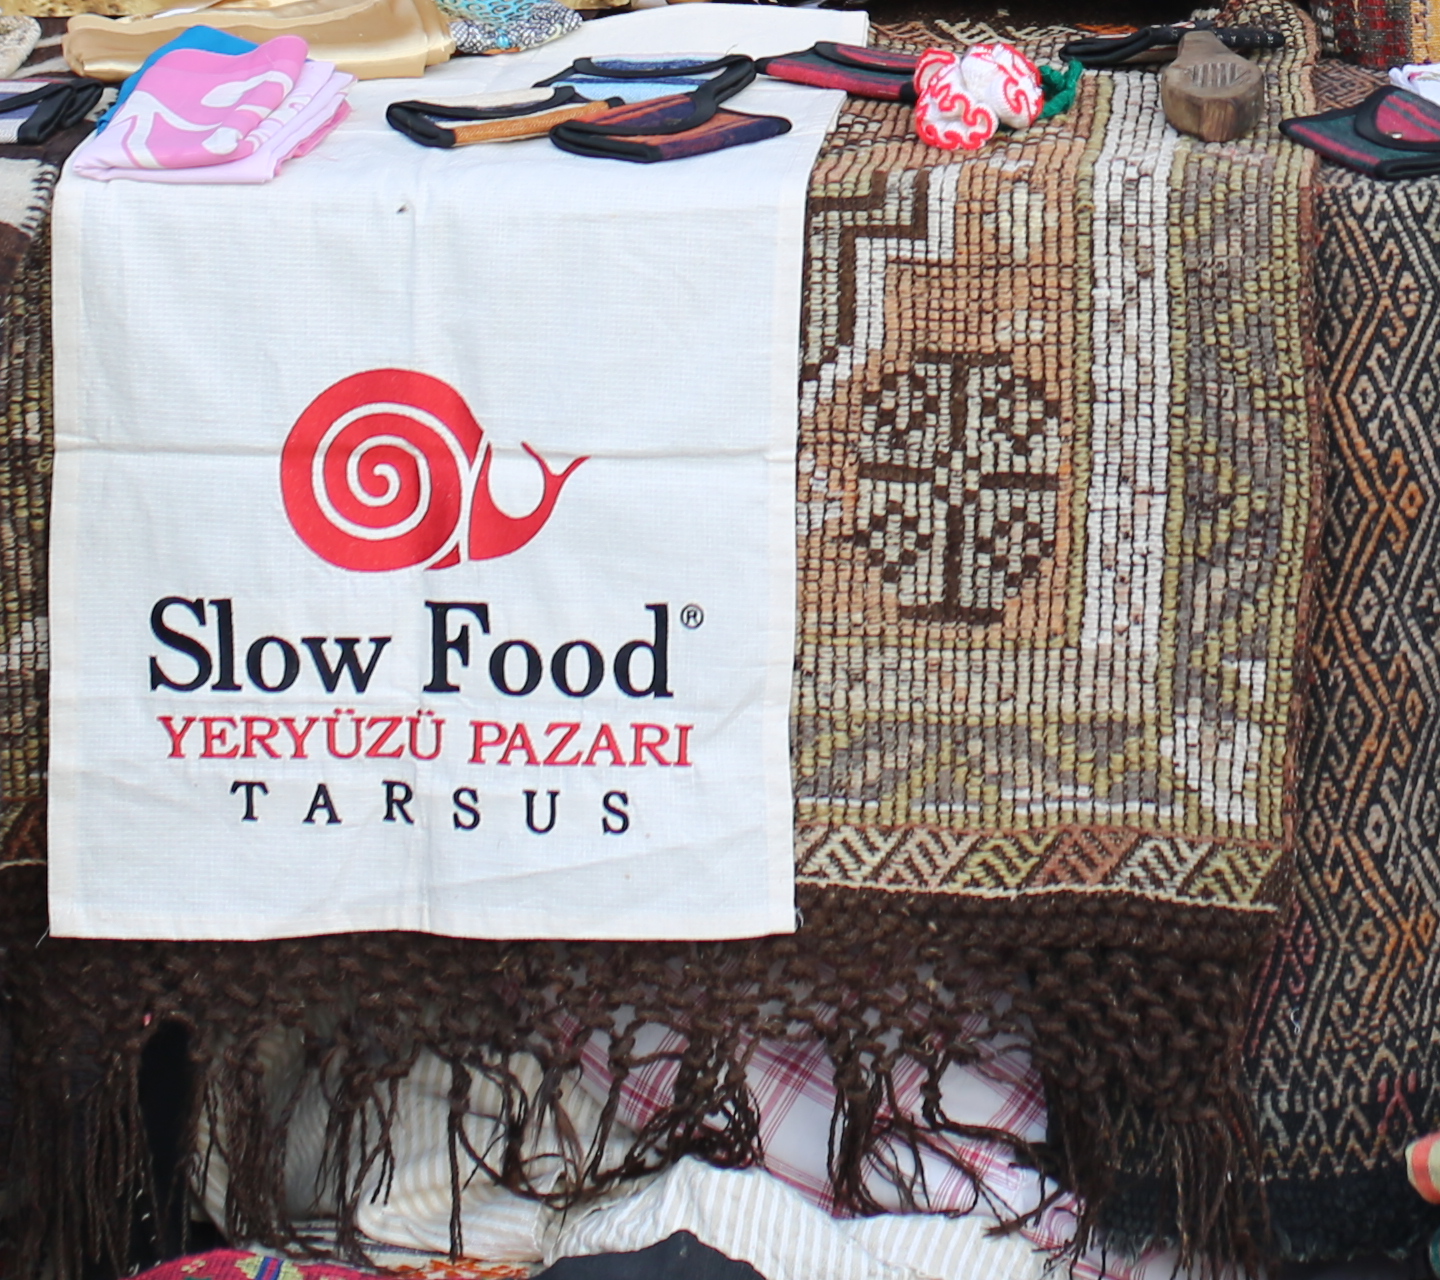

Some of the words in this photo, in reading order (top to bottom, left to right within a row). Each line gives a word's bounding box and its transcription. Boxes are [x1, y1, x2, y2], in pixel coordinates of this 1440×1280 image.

[148, 596, 391, 694] Slow
[158, 708, 443, 760] YERYÜZÜ
[469, 721, 693, 767] PAZARI
[230, 780, 631, 835] TARSUS
